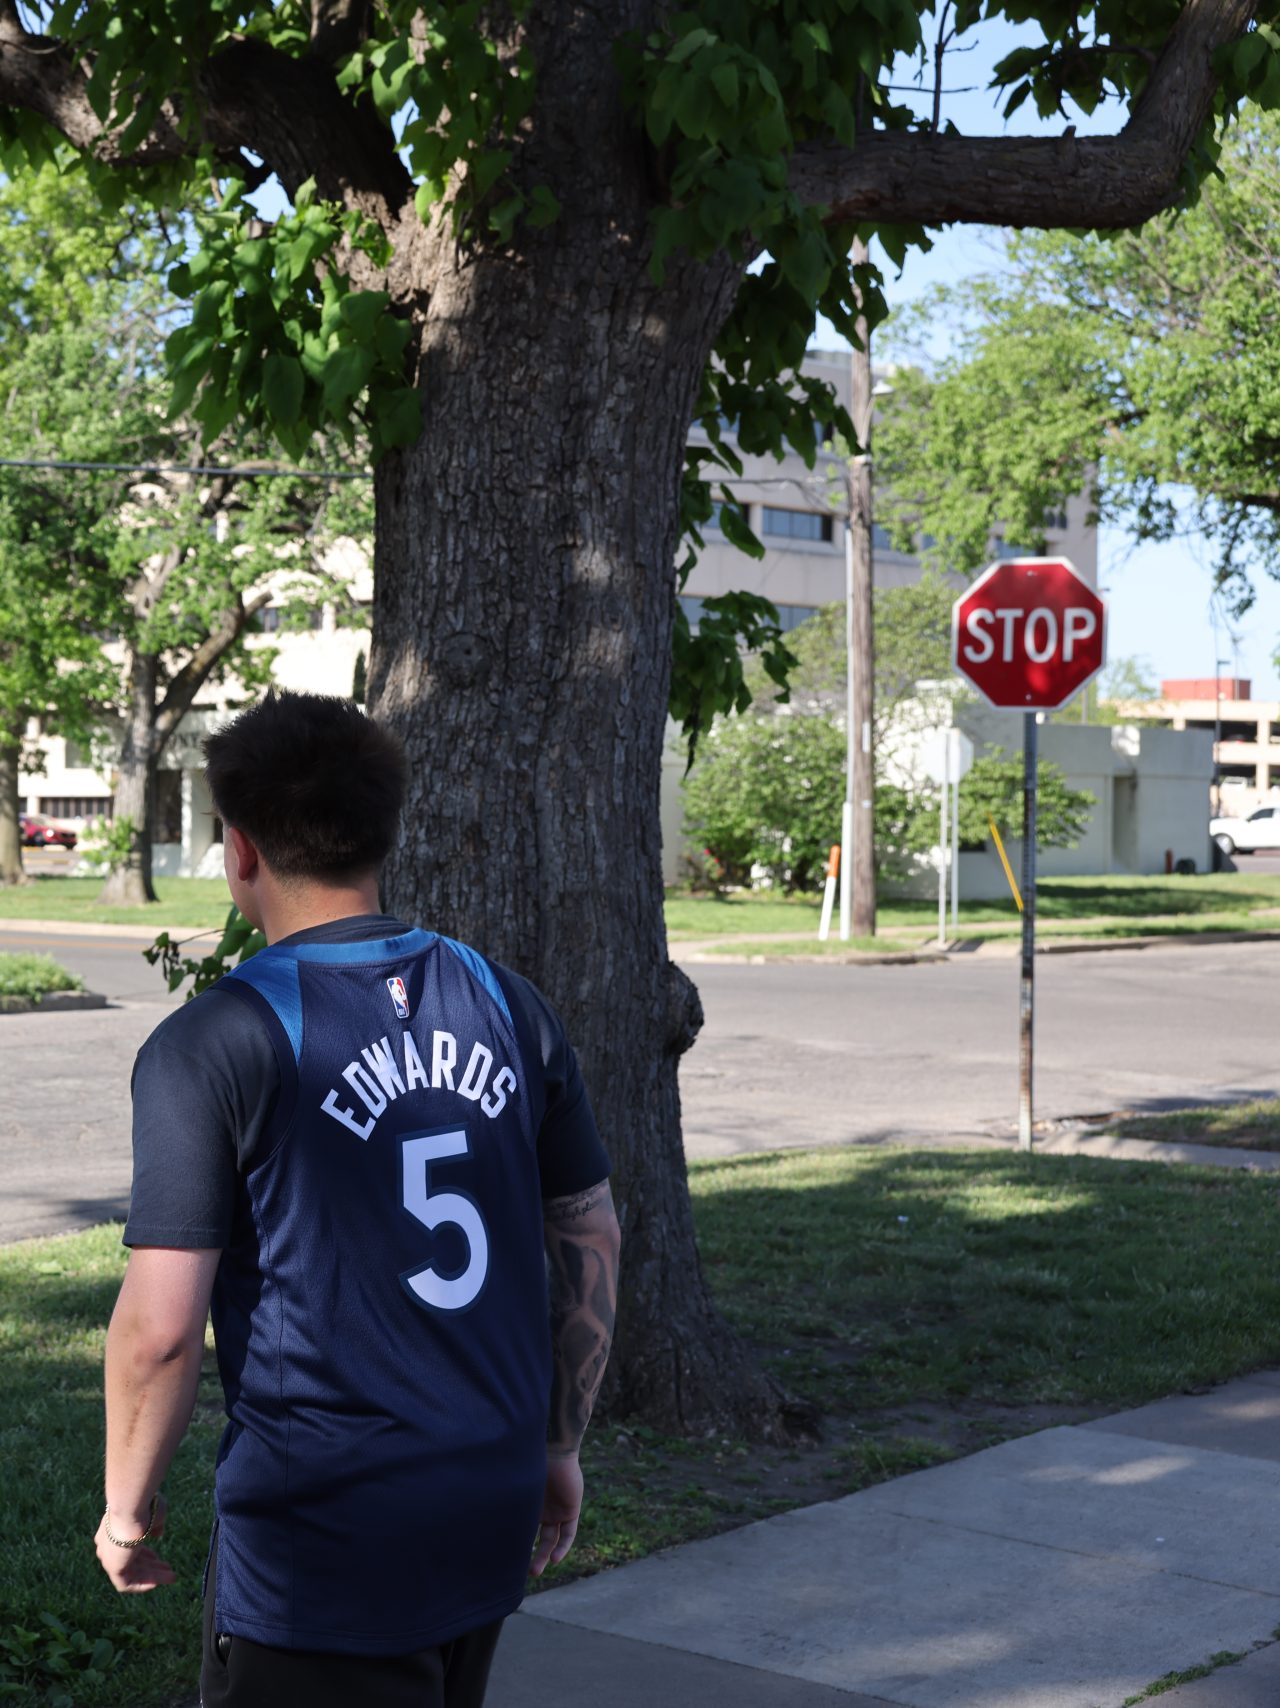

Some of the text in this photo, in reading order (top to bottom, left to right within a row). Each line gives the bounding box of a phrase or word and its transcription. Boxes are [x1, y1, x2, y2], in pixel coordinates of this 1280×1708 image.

[963, 607, 1096, 663] STOP
[320, 1030, 517, 1141] EDWARDS
[401, 1129, 489, 1310] 5
